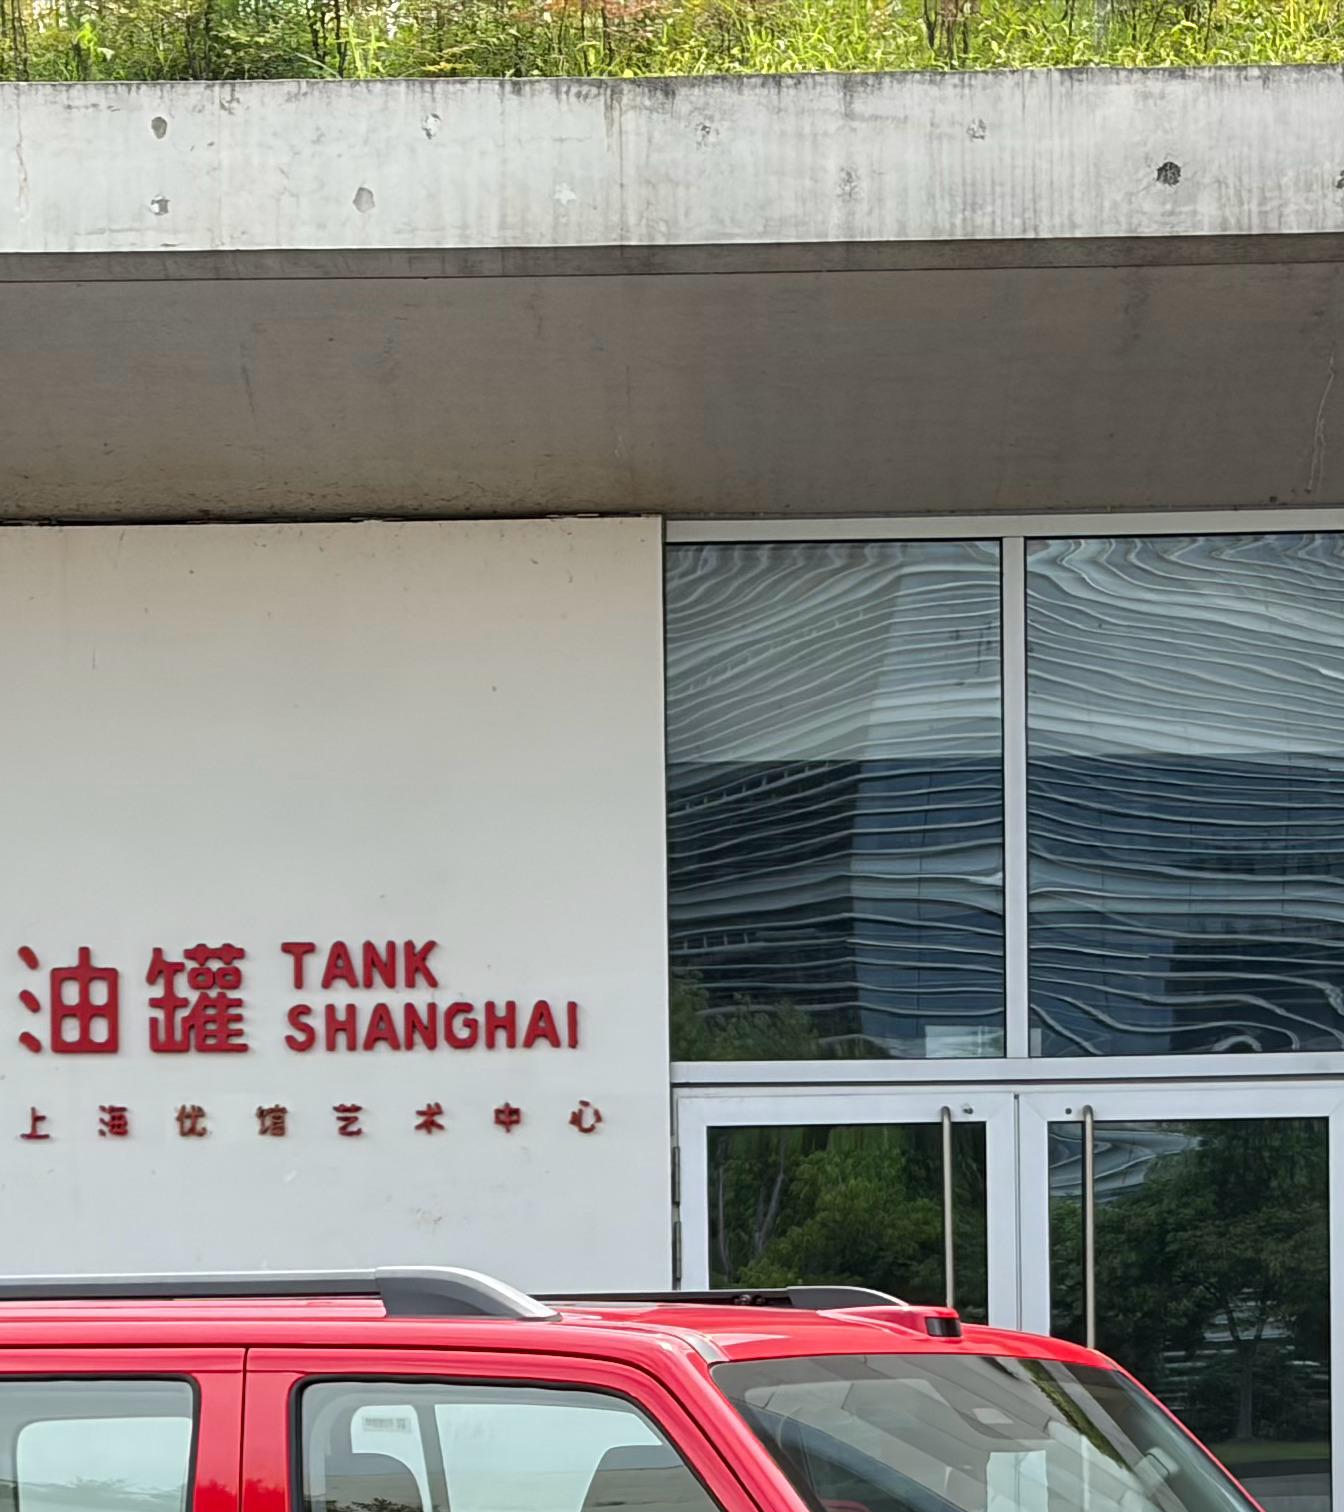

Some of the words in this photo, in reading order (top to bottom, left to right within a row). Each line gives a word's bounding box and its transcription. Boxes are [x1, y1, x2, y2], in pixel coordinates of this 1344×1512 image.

[281, 940, 438, 990] TANK
[17, 943, 249, 1054] 油罐
[284, 999, 579, 1053] SHANGHAI
